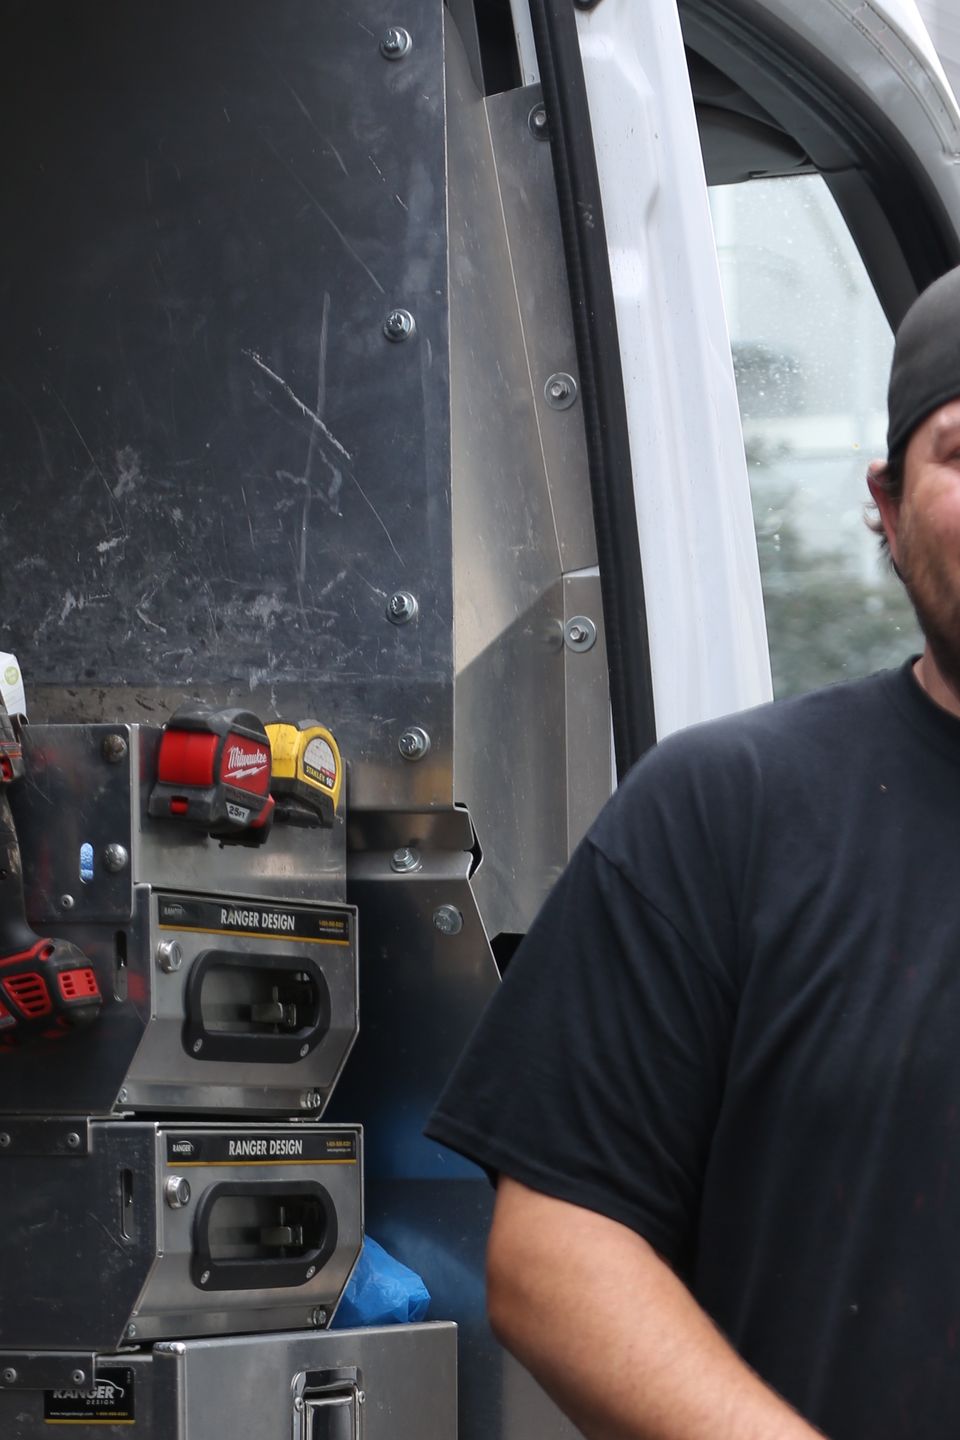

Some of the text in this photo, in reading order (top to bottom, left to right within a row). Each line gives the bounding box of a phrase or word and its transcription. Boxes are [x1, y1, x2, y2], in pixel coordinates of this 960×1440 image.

[228, 746, 267, 769] Milwaukee
[220, 908, 260, 928] RANGER
[261, 912, 296, 931] DESIGN
[228, 1139, 303, 1156] RANGER DESIGN
